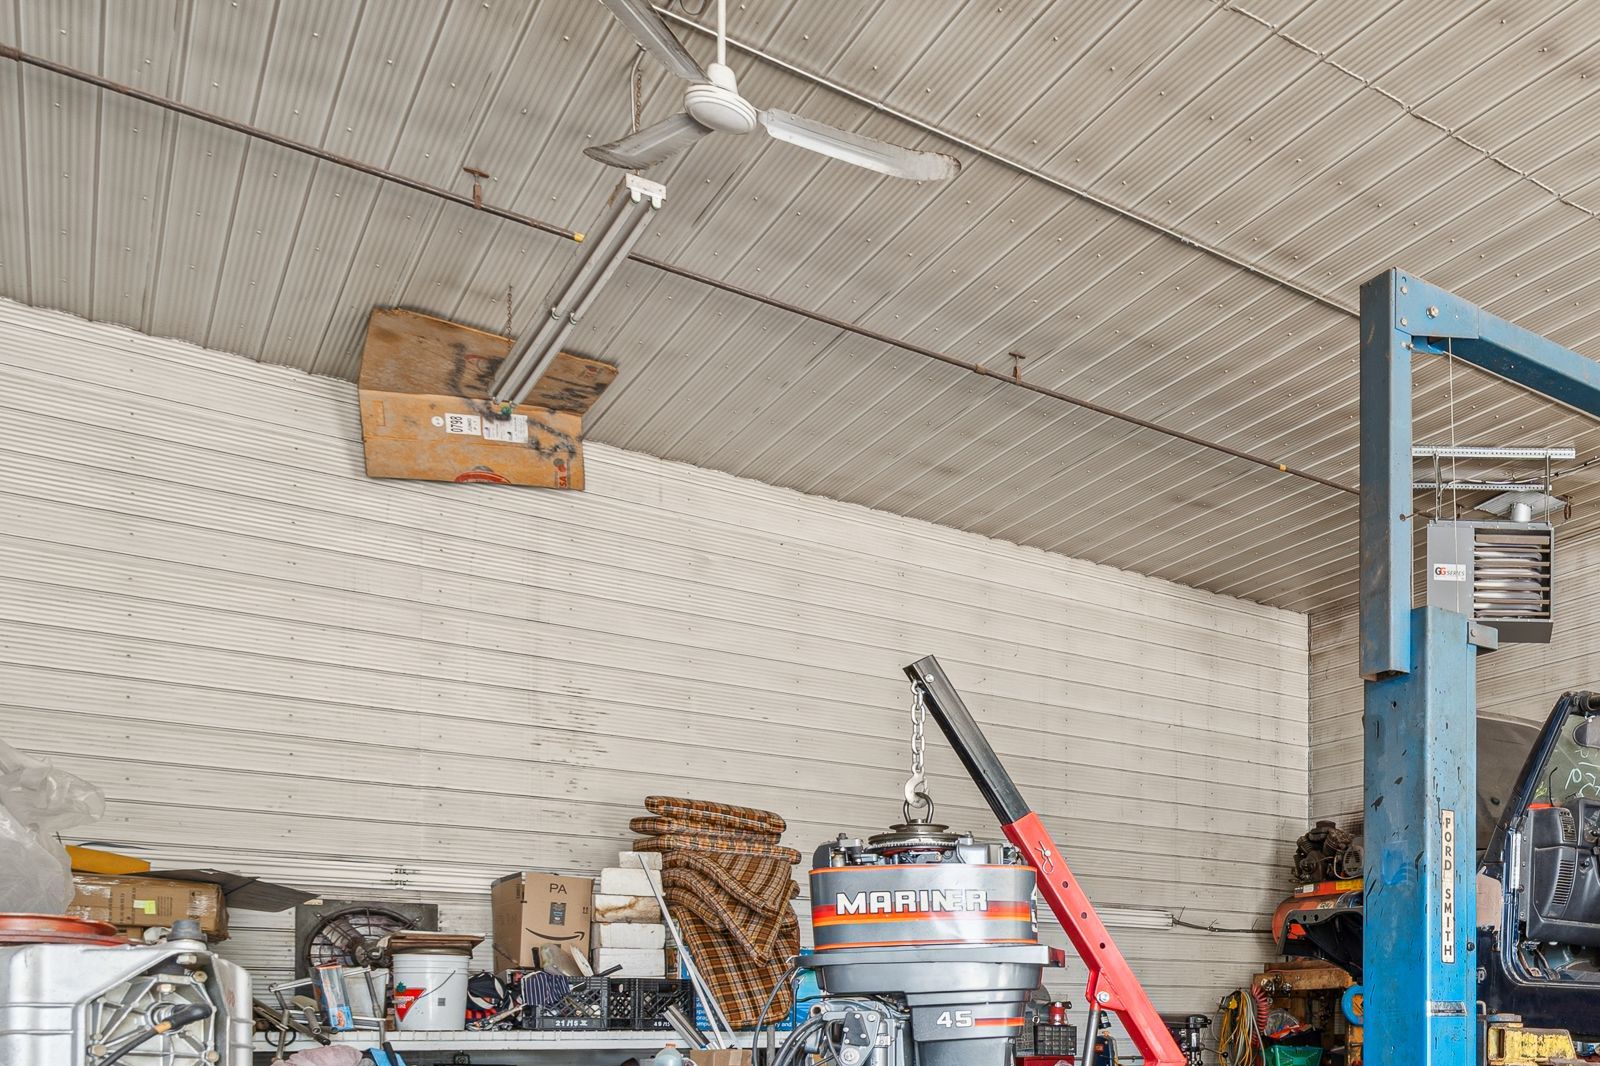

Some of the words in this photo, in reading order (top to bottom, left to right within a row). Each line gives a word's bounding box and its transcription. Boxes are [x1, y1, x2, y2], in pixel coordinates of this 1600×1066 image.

[549, 883, 567, 895] PA
[836, 889, 988, 915] MARINER
[1444, 888, 1452, 957] SMITH
[936, 1010, 973, 1027] 45
